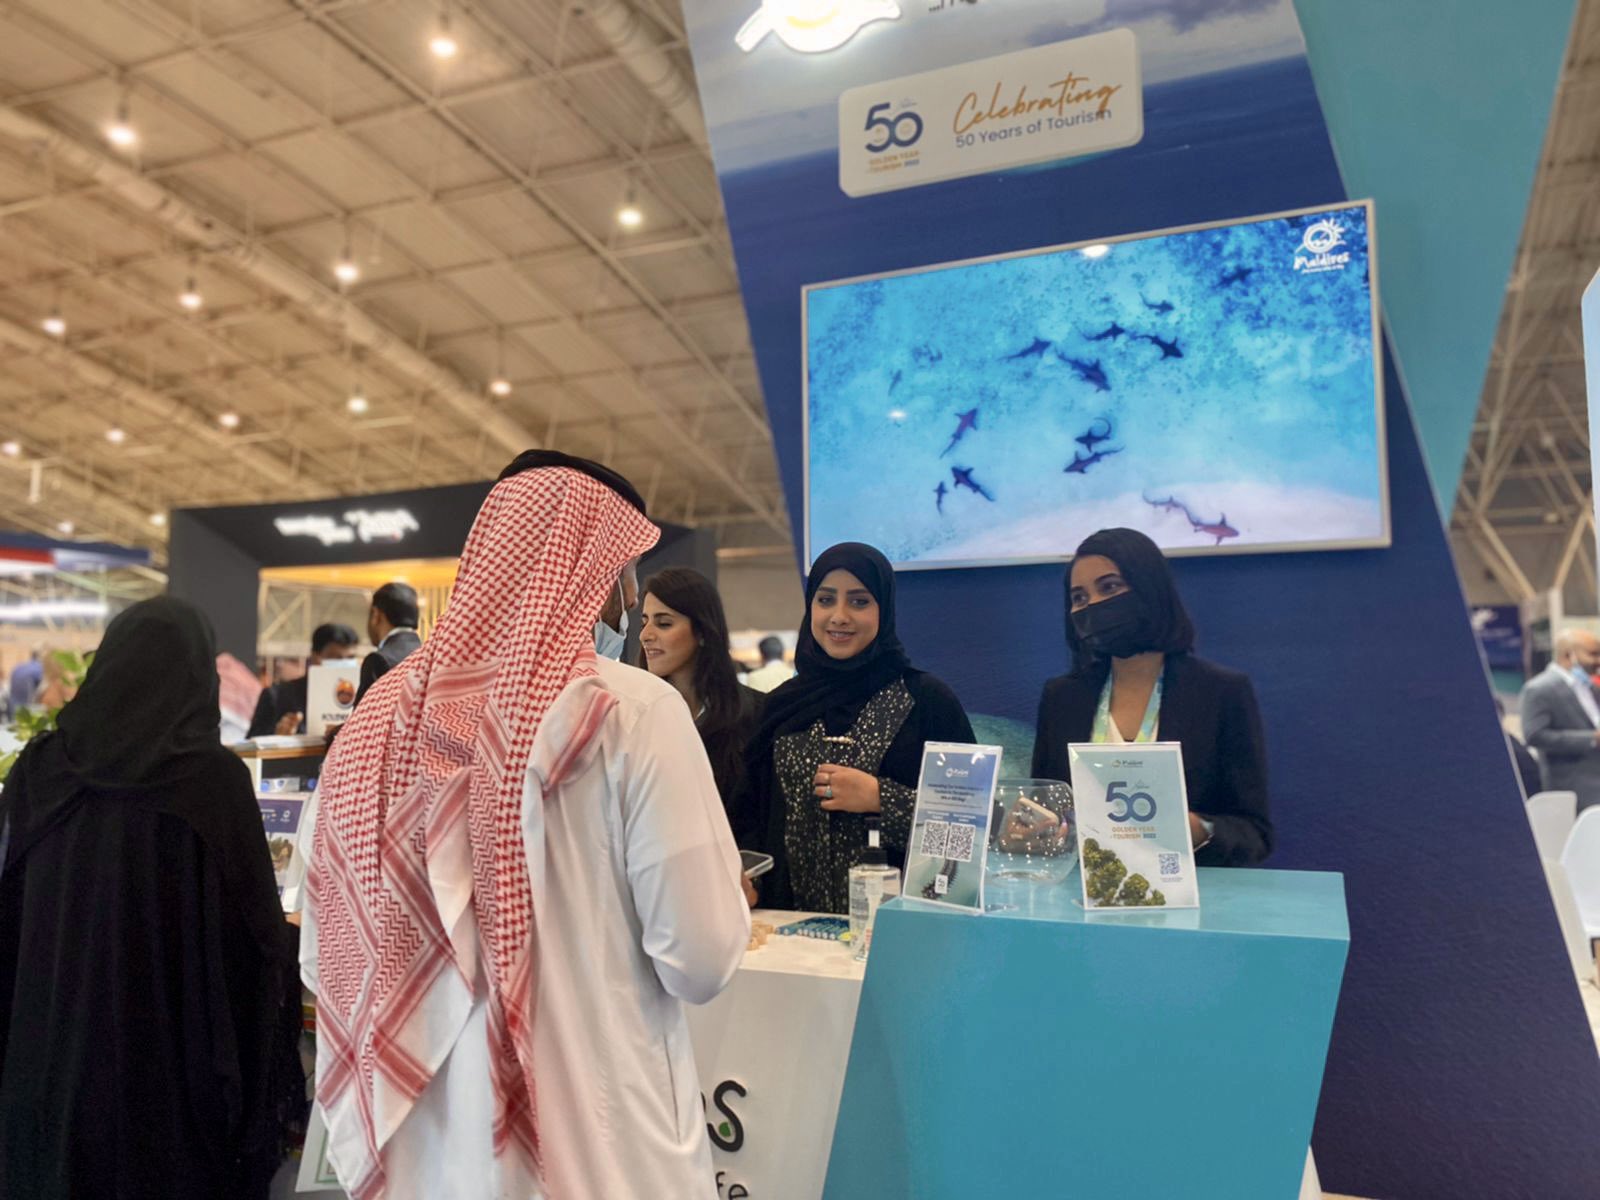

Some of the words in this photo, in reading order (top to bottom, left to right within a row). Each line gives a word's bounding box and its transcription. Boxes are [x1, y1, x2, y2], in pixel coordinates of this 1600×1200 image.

[953, 72, 1122, 134] Celebrating
[864, 102, 923, 153] 50
[956, 133, 975, 148] 50
[979, 124, 1022, 143] Years
[1027, 121, 1042, 134] of
[1047, 109, 1112, 130] Tourism
[1105, 781, 1157, 823] 50
